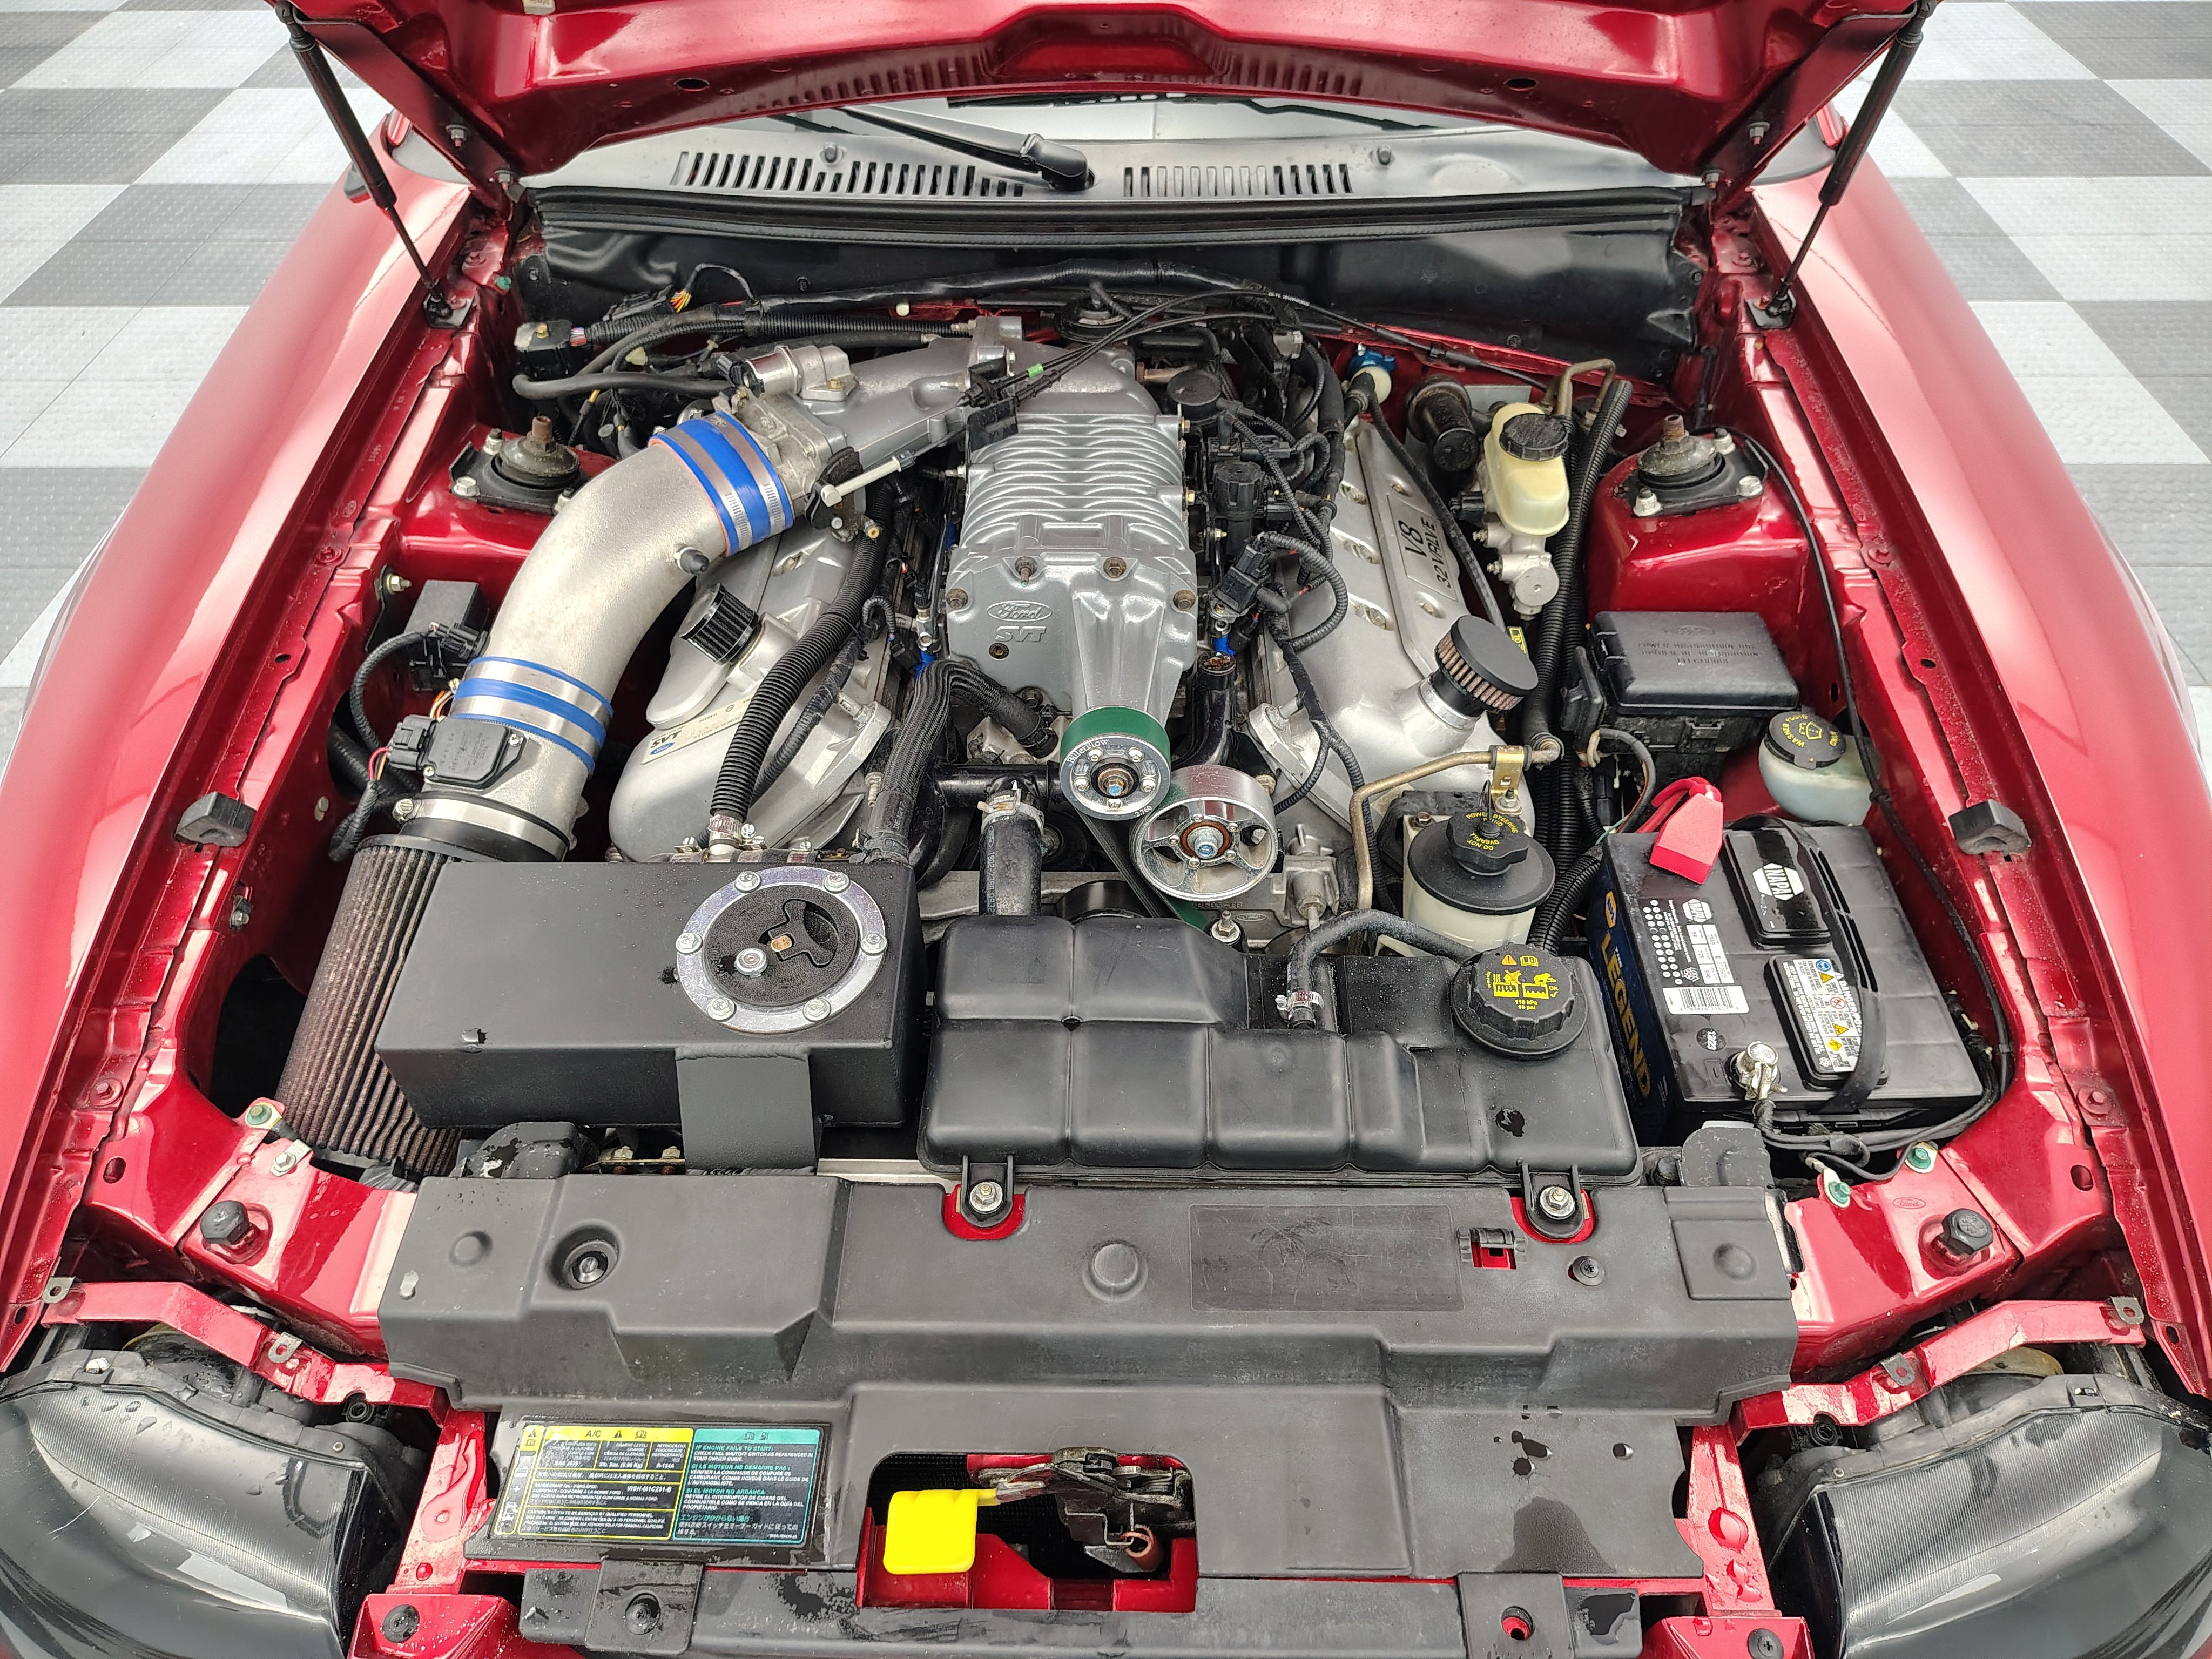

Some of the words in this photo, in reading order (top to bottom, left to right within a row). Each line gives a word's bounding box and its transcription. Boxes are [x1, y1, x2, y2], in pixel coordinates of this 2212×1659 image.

[1398, 520, 1427, 557] V8
[1421, 517, 1444, 565] VALVE
[1436, 567, 1451, 589] 32
[997, 603, 1042, 619] Ford
[995, 625, 1046, 643] SVT
[650, 730, 682, 748] SVT
[1782, 723, 1805, 747] WASHER
[1067, 739, 1109, 764] BilletFlow
[1466, 812, 1488, 820] POWE
[1469, 833, 1500, 845] OVERFILL
[1764, 869, 1792, 895] NAPA
[1689, 903, 1706, 919] NAPA
[1601, 933, 1651, 1098] LEGEND
[1707, 1031, 1717, 1050] 12/23
